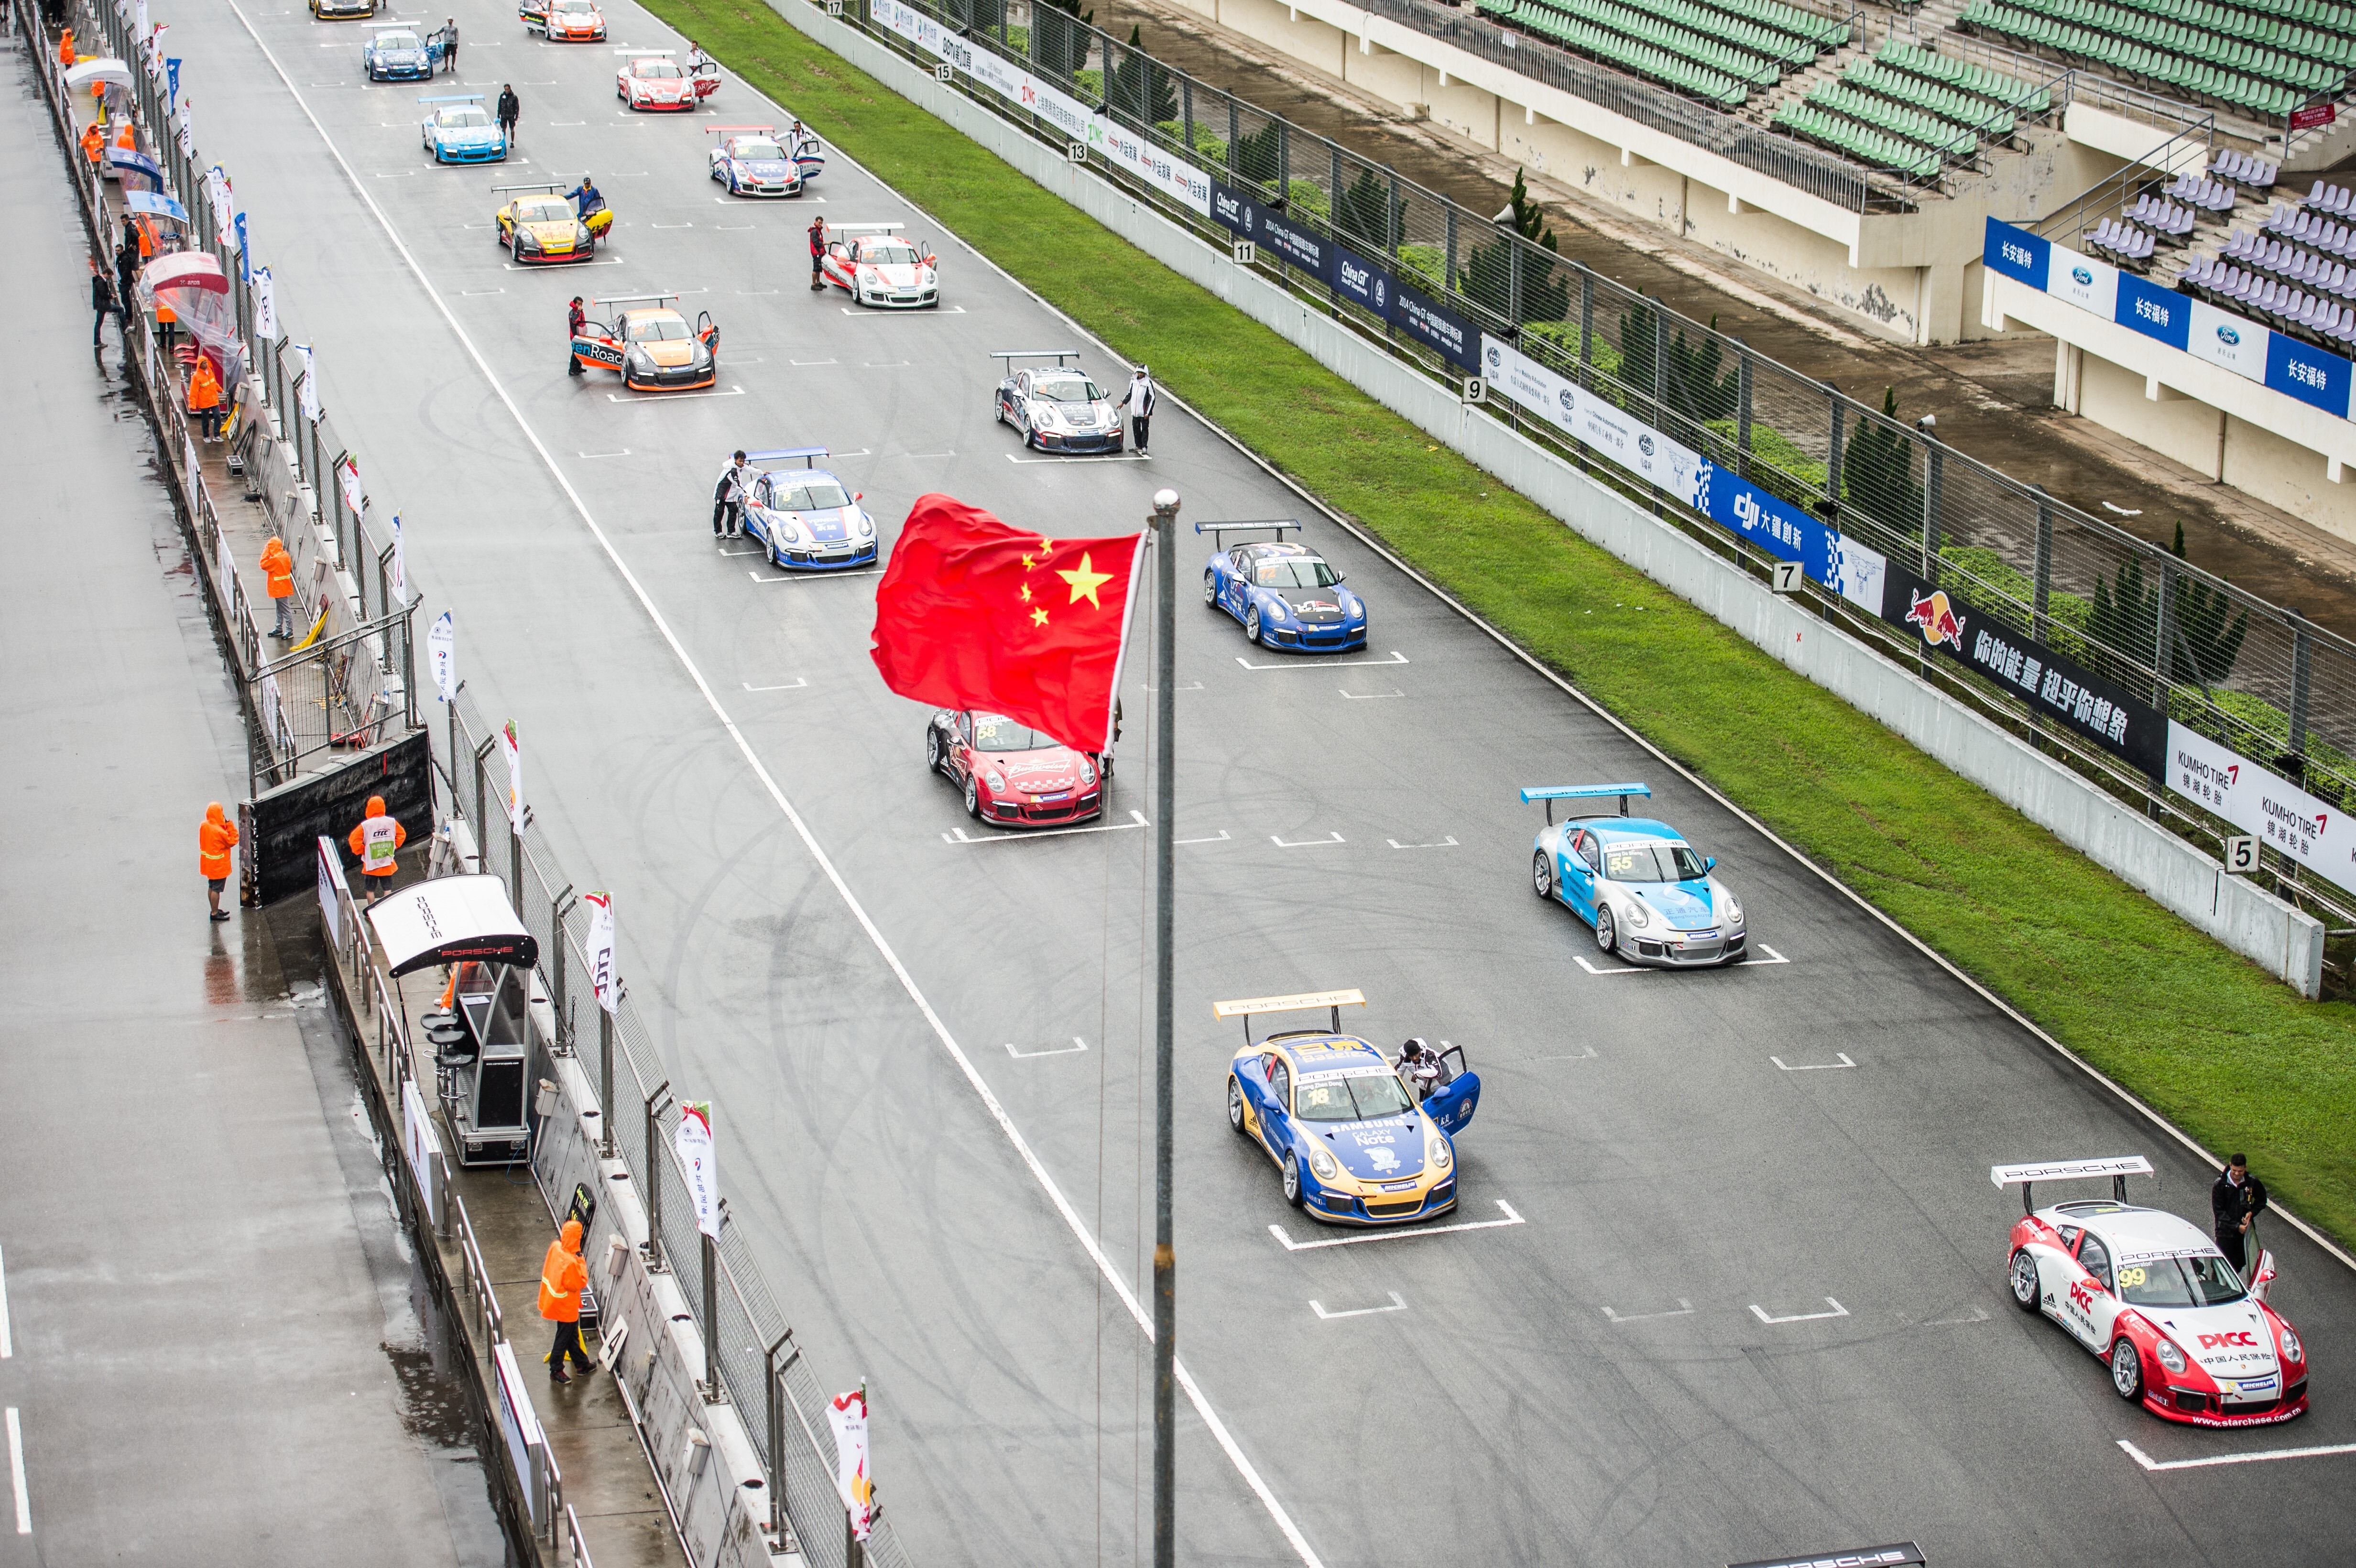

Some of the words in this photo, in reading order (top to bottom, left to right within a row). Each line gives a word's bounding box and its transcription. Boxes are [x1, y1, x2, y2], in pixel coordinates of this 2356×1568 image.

[829, 2, 840, 13] 17
[938, 66, 949, 78] 15
[1071, 145, 1084, 159] 13
[1119, 138, 1137, 163] 外运发展
[1152, 158, 1171, 182] 外运发展
[1188, 177, 1207, 203] 外运发展
[1217, 192, 1230, 212] China
[1230, 199, 1239, 215] GT
[1265, 219, 1275, 231] 2014
[1275, 224, 1284, 237] China
[1284, 229, 1289, 240] GT
[1237, 244, 1251, 260] 11
[2002, 240, 2032, 269] 长安福特
[1342, 261, 1358, 282] China
[1358, 270, 1369, 286] GT
[2075, 269, 2089, 284] Ford
[1399, 295, 1409, 310] 2014
[1409, 301, 1420, 316] China
[1420, 308, 1427, 319] GT
[2135, 297, 2169, 327] 长安福特
[2220, 327, 2236, 344] Ford
[2288, 358, 2327, 391] 长安福特
[1469, 380, 1481, 400] 9
[783, 492, 791, 502] 8
[1761, 510, 1802, 551] 大疆創新
[1781, 566, 1794, 588] 7
[1974, 629, 2041, 693] 你的能量
[2040, 668, 2128, 745] 超乎你想象
[978, 726, 996, 740] 58
[1004, 761, 1071, 775] Budweiser
[2178, 750, 2209, 779] KUMHO
[2211, 768, 2229, 790] TIRE
[1535, 787, 1638, 796] PORSCHE
[2183, 773, 2222, 806] 锦湖轮胎
[2262, 796, 2296, 827] KUMHO
[2298, 816, 2317, 839] TIRE
[1608, 841, 1685, 850] PORSCHE
[2267, 819, 2309, 856] 锦湖轮胎
[2235, 840, 2251, 867] 5
[1610, 857, 1632, 871] 55
[414, 896, 442, 939] PORSCHE
[1664, 906, 1710, 915] 正通汽车
[442, 946, 513, 957] PORSCHE
[1229, 995, 1351, 1011] PORSCHE
[1299, 1067, 1391, 1082] PORSCHE
[1308, 1089, 1330, 1105] 18
[1330, 1119, 1405, 1133] SAMSUNG
[1352, 1129, 1391, 1138] GALAXY
[1355, 1135, 1396, 1146] Note
[2004, 1162, 2141, 1178] PORSCHE
[1385, 1182, 1415, 1190] MICHELIN
[2121, 1248, 2217, 1262] PORSCHE
[2118, 1261, 2153, 1271] A.Imperatori
[2118, 1267, 2146, 1288] 99
[2042, 1298, 2057, 1309] adidas
[2070, 1281, 2093, 1315] PICC
[2065, 1301, 2096, 1335] 中国人民保险
[608, 1328, 623, 1360] 4
[2196, 1331, 2258, 1350] PICC
[2203, 1353, 2272, 1366] 中国人民保险
[2242, 1379, 2274, 1389] MICHELIN
[2148, 1389, 2163, 1403] Mobil
[2192, 1407, 2301, 1427] www.starchase.com.cn
